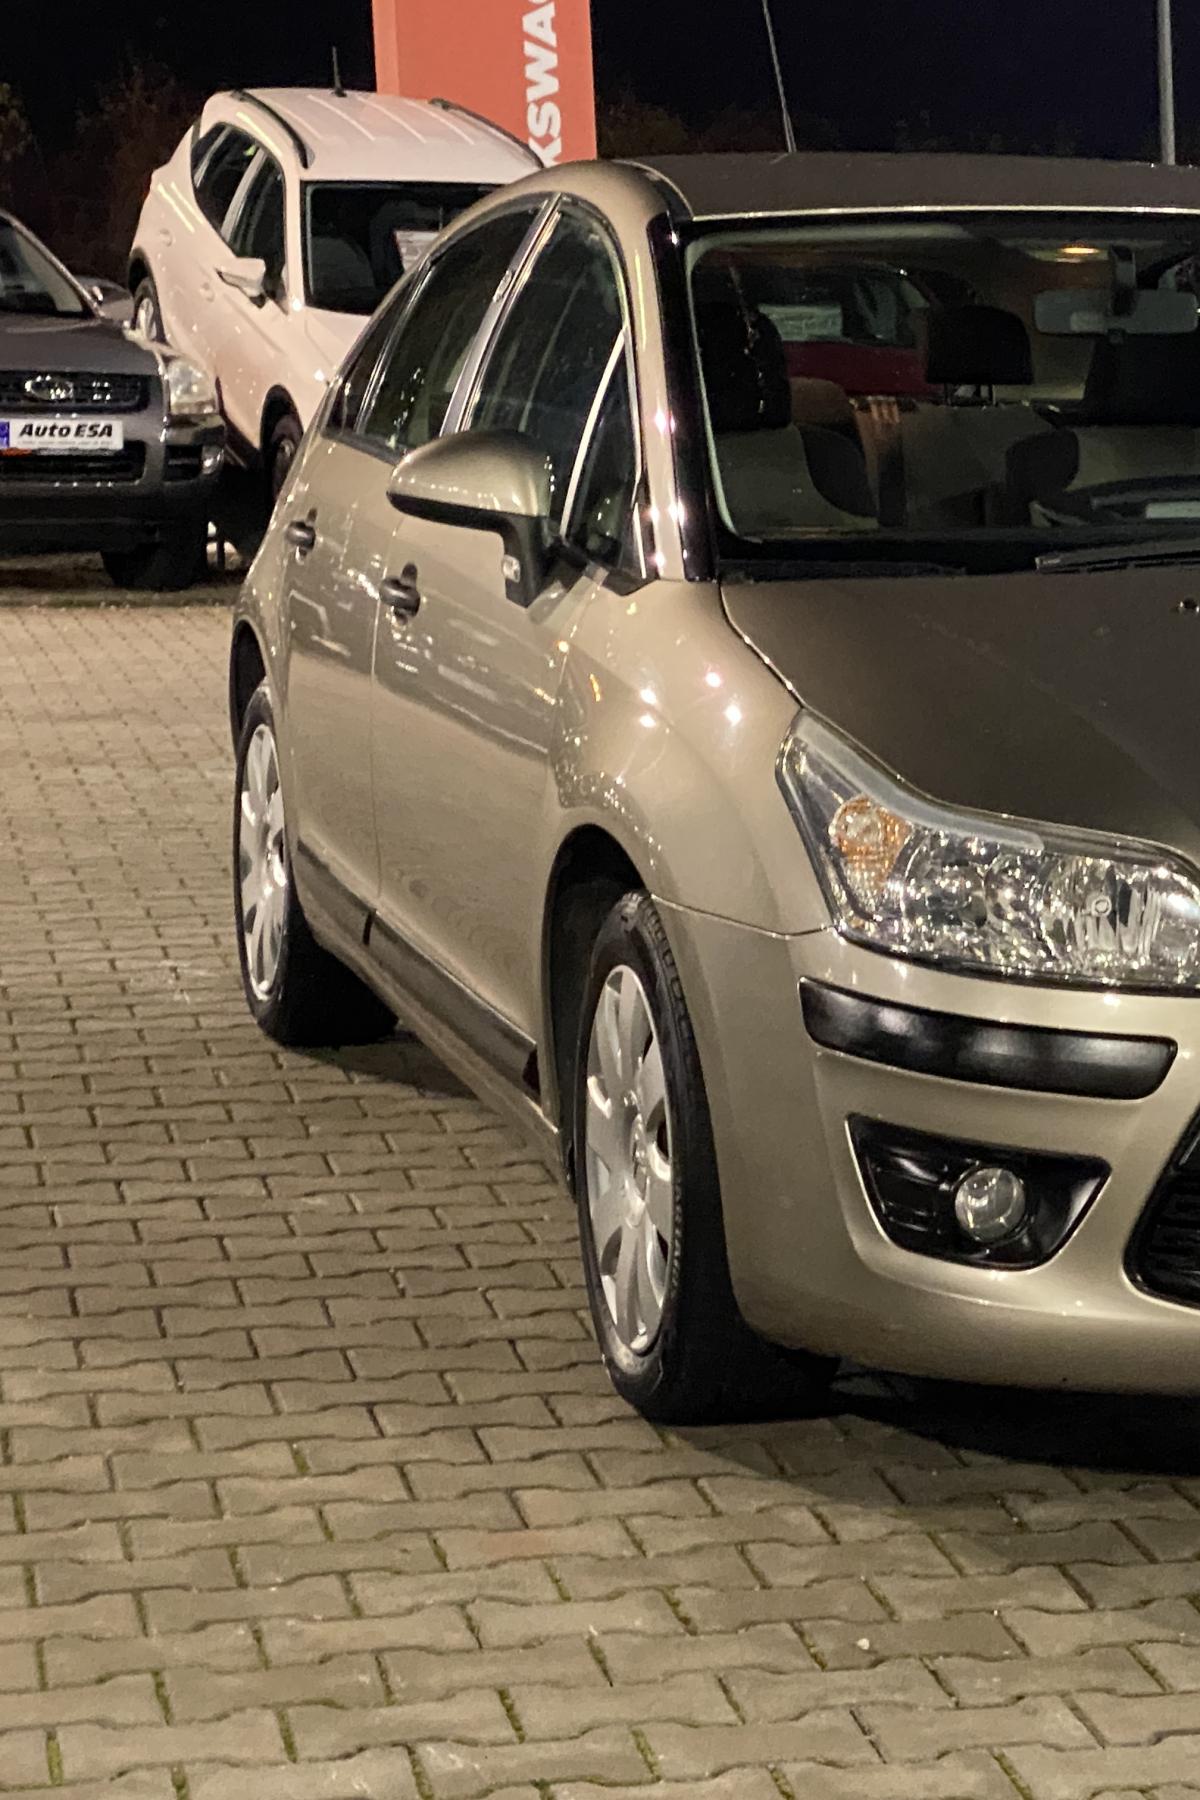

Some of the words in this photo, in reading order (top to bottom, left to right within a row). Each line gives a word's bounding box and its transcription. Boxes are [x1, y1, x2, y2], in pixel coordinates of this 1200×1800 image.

[522, 0, 562, 168] KSWA
[19, 423, 71, 437] Auto
[74, 424, 113, 438] ESA
